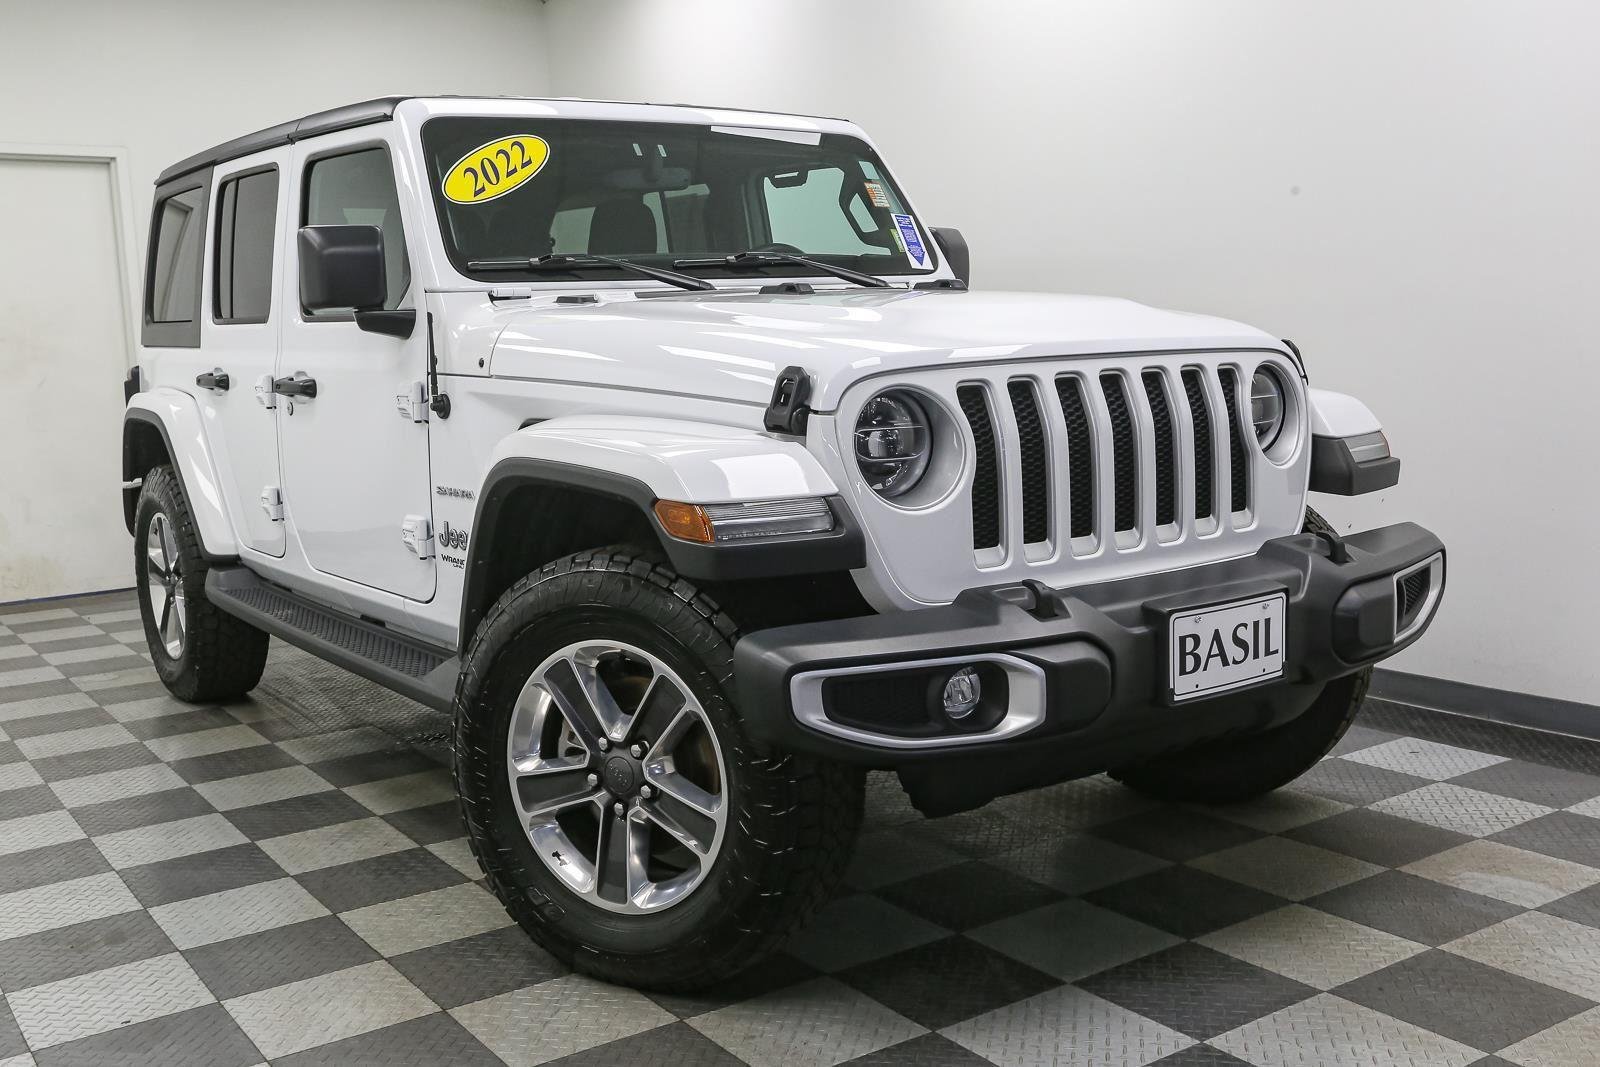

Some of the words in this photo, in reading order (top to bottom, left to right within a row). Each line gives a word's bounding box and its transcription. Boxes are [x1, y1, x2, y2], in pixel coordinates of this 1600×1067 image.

[463, 141, 533, 197] 2022
[439, 521, 468, 551] Jee
[1178, 617, 1280, 677] BASIL
